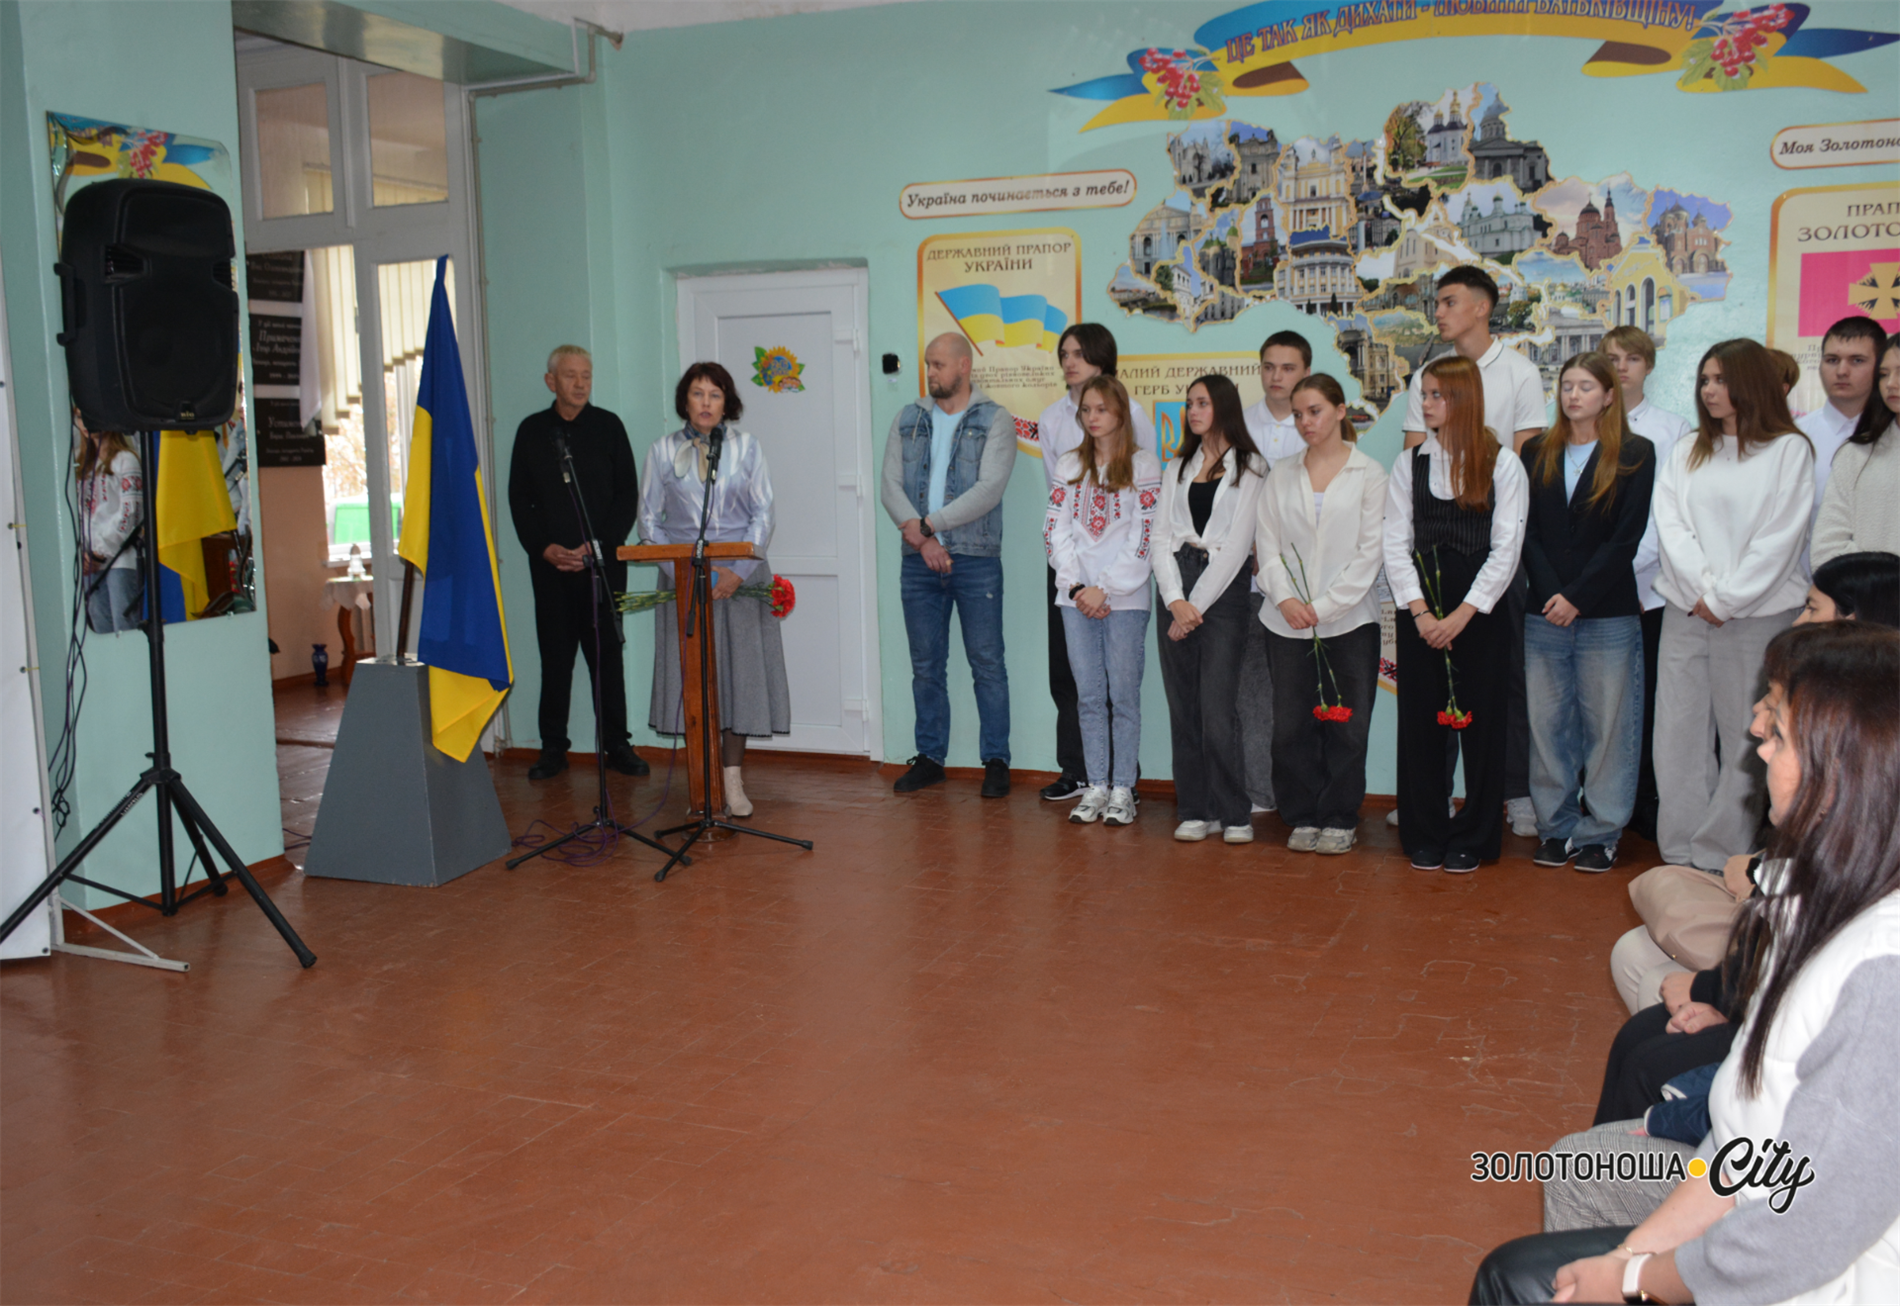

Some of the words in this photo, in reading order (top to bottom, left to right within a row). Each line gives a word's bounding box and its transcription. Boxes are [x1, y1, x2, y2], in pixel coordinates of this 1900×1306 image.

[1225, 32, 1255, 64] ЦЕ
[1257, 18, 1298, 51] ТАК
[1301, 10, 1332, 40] ЯК
[1333, 0, 1417, 37] ДИХАТИ
[1779, 141, 1814, 155] Моя
[907, 192, 967, 210] Україна
[971, 187, 1068, 204] починається
[1072, 187, 1081, 197] з
[1086, 180, 1130, 196] тебе!
[1847, 202, 1900, 217] ПРАП
[1797, 222, 1900, 242] ЗОЛОТО
[926, 244, 1012, 262] ДЕРЖАВНИЙ
[1016, 242, 1073, 256] ПРАПОР
[964, 258, 1033, 273] УКРАЇНИ
[1114, 366, 1160, 379] АЛИЙ
[1134, 384, 1170, 396] ГЕРБ
